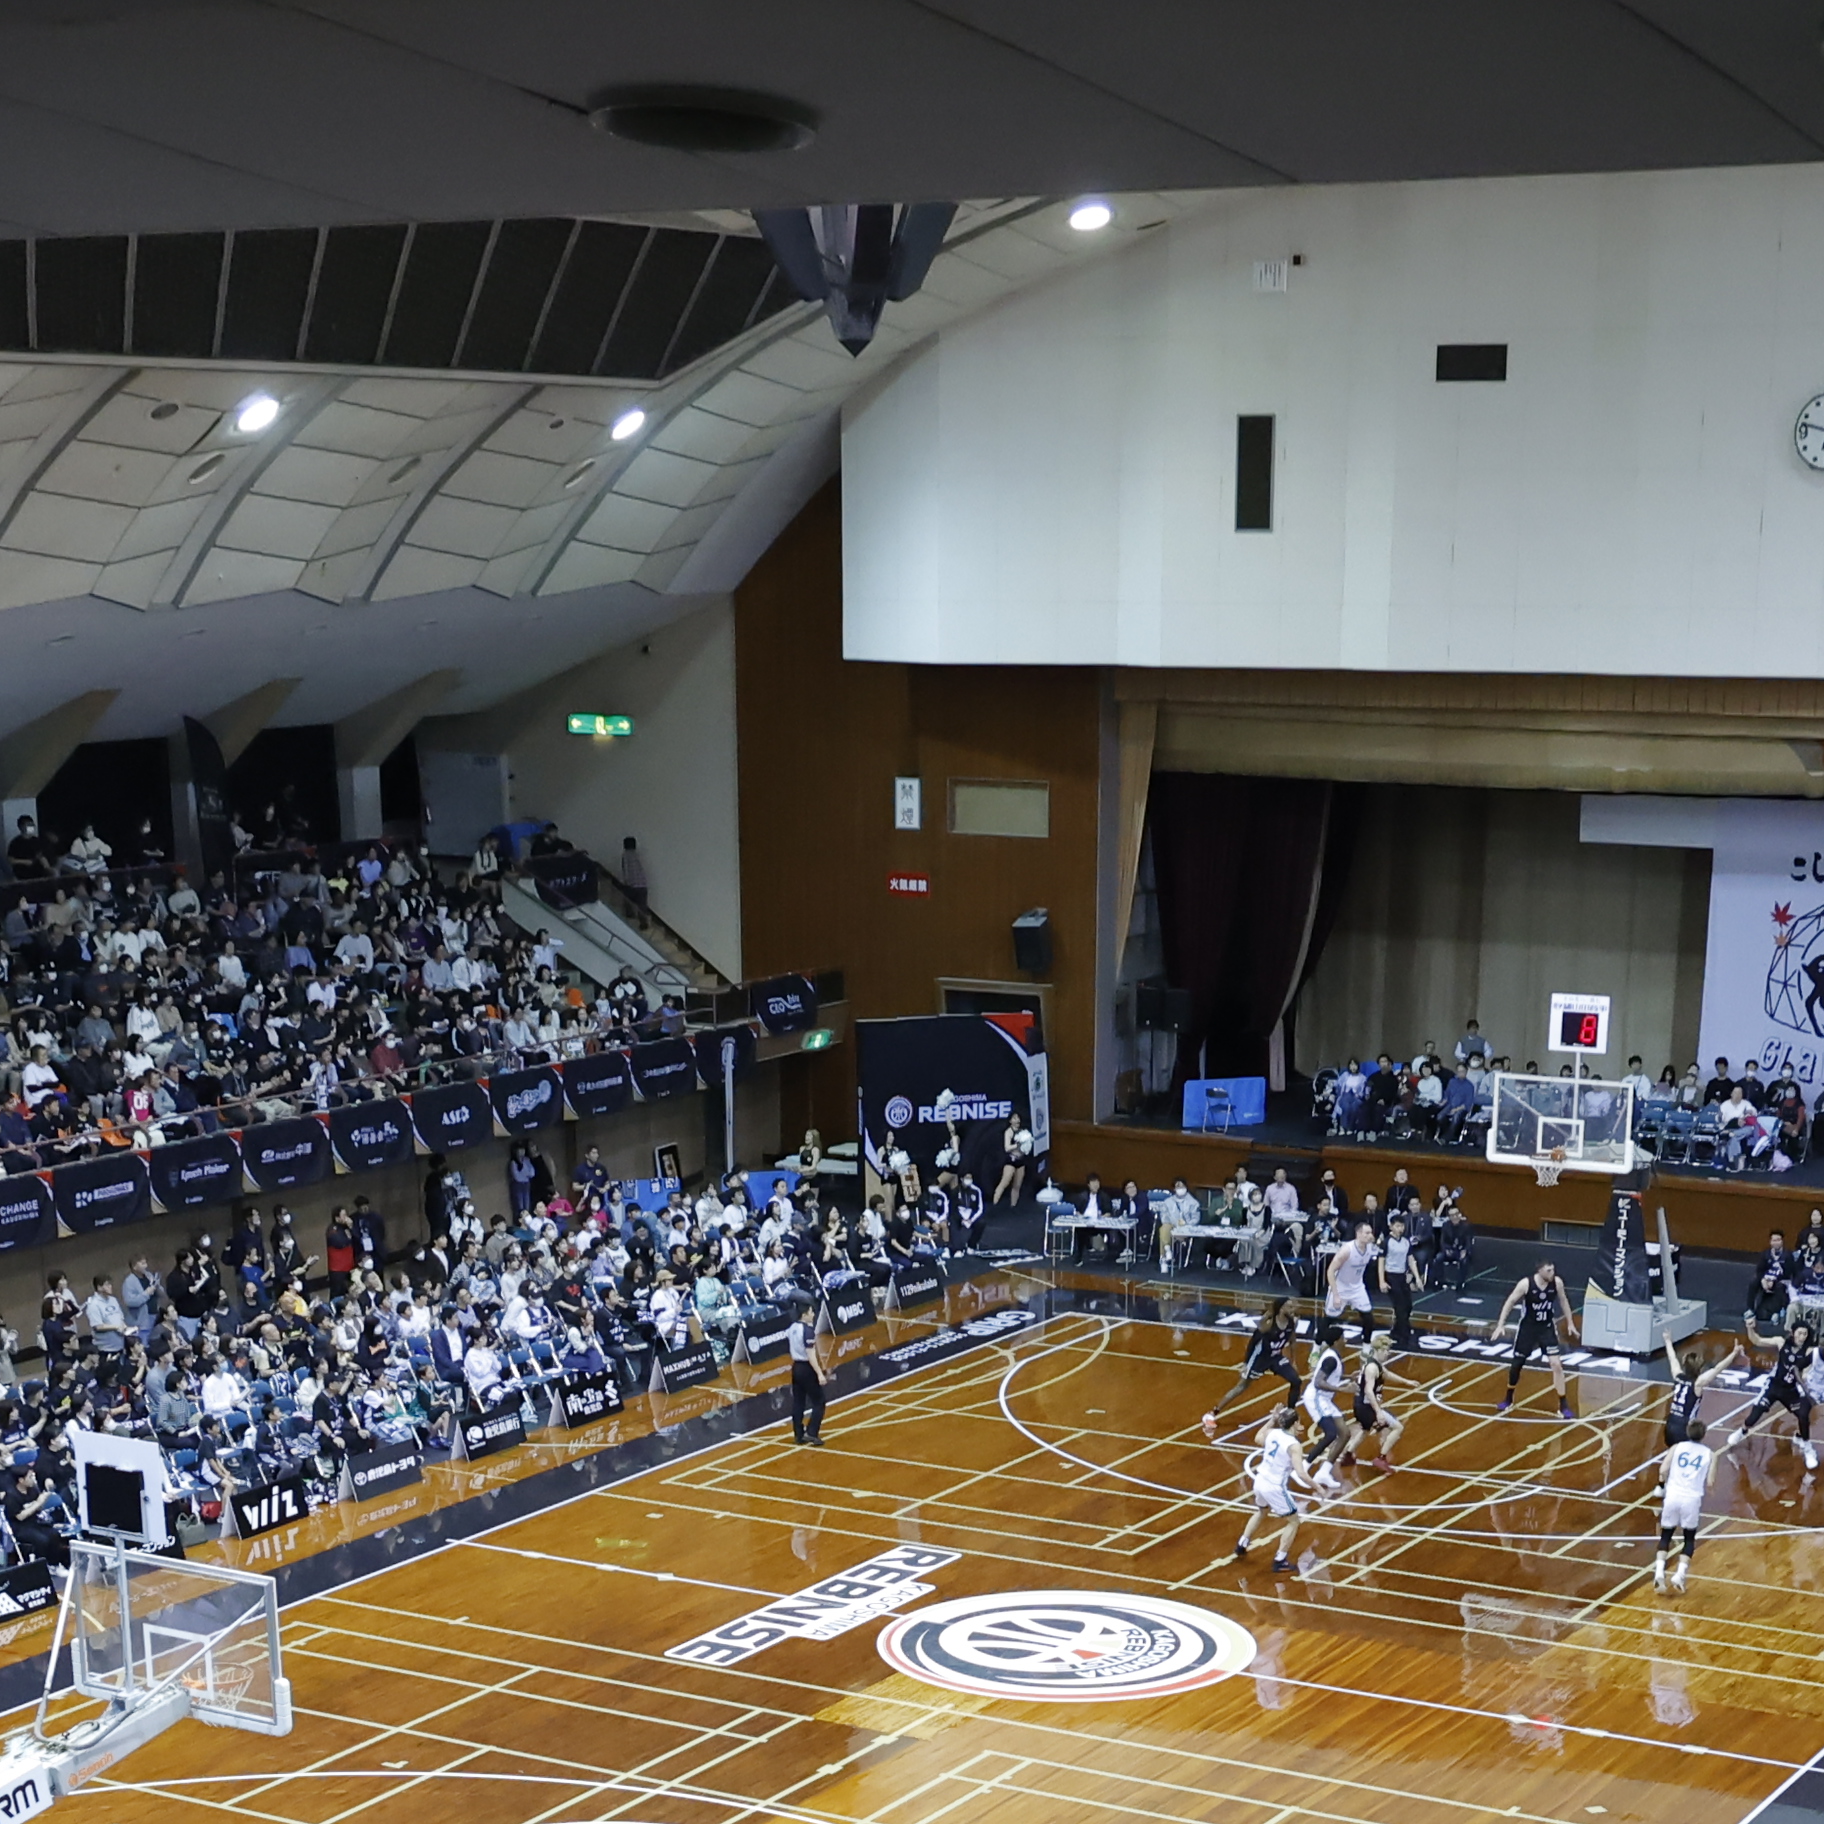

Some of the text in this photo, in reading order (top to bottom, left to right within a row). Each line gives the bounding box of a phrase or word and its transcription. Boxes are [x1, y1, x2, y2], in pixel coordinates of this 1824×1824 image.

[900, 782, 915, 825] 禁煙
[1579, 1014, 1598, 1043] 8
[0, 1199, 39, 1218] CHANGE
[844, 1302, 866, 1319] MBC
[673, 1547, 954, 1664] REBNISE
[807, 1583, 924, 1637] KAGOSHIMA
